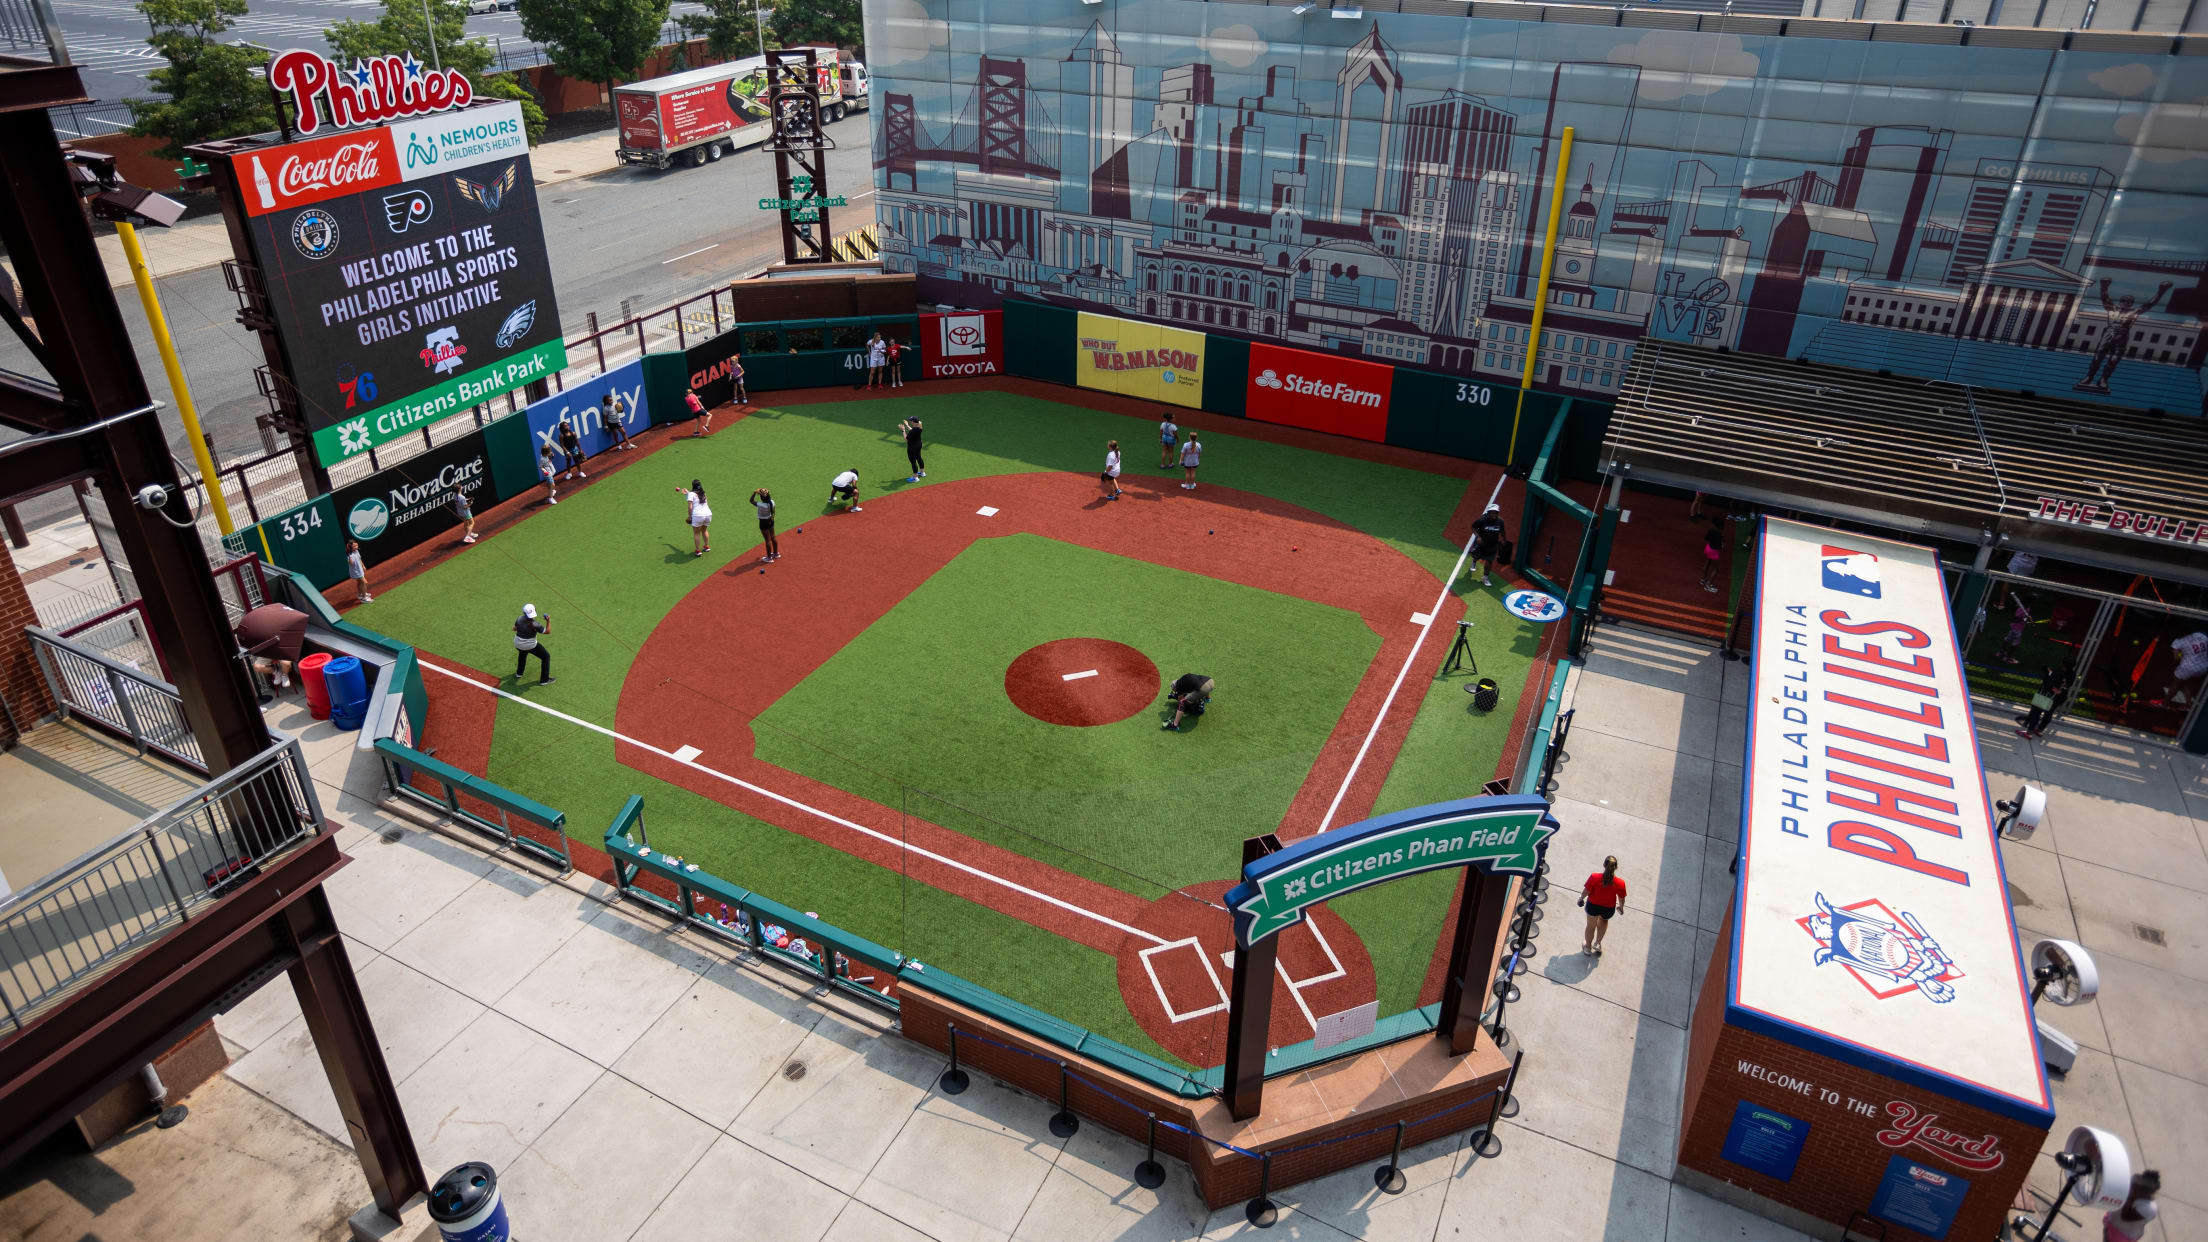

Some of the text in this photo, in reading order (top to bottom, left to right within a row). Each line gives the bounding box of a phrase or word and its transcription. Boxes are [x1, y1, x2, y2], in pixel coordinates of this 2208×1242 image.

[270, 49, 473, 135] Phillies
[441, 119, 518, 147] NEMOURS
[444, 136, 520, 161] CHILDREN'S HEALTH
[278, 140, 379, 197] Coca-Cola
[1984, 164, 2011, 178] GO
[758, 194, 848, 210] Citizens Bank
[790, 208, 820, 222] Park
[341, 225, 495, 288] WELCOME TO THE
[321, 246, 519, 326] PHILADELPHIA SPORTS
[357, 280, 502, 346] GIRLS INITIATIVE
[420, 345, 467, 367] Phillies
[1081, 339, 1117, 351] WHO BUT
[932, 361, 996, 377] TOYOTA
[1284, 373, 1382, 408] StateFarm
[377, 353, 546, 435] Citizens Bank Park
[1456, 383, 1491, 406] 330
[537, 384, 641, 456] xfinty
[389, 457, 483, 513] NovaCare
[280, 506, 323, 542] 334
[2037, 496, 2100, 525] THE
[1781, 605, 1809, 839] PHILADELPHIA
[1819, 609, 1970, 887] PHILLIES
[1309, 825, 1521, 890] Citizens Phan Field
[1737, 1059, 2004, 1170] WELCOME TO THE Yard
